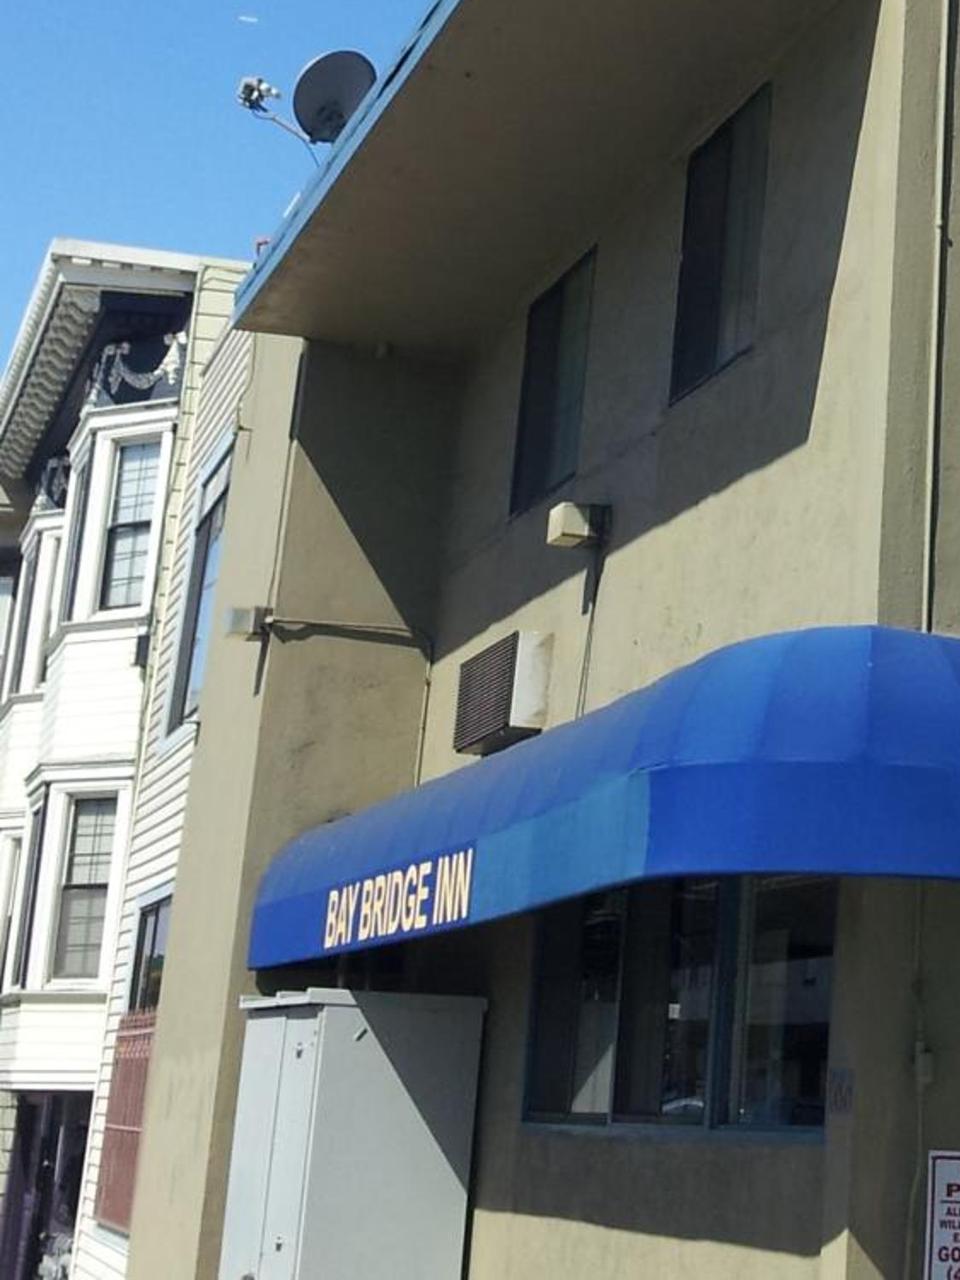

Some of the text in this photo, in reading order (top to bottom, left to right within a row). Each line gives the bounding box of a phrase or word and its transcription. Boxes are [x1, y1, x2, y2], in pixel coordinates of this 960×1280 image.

[324, 847, 474, 950] BAY BRIDGE INN
